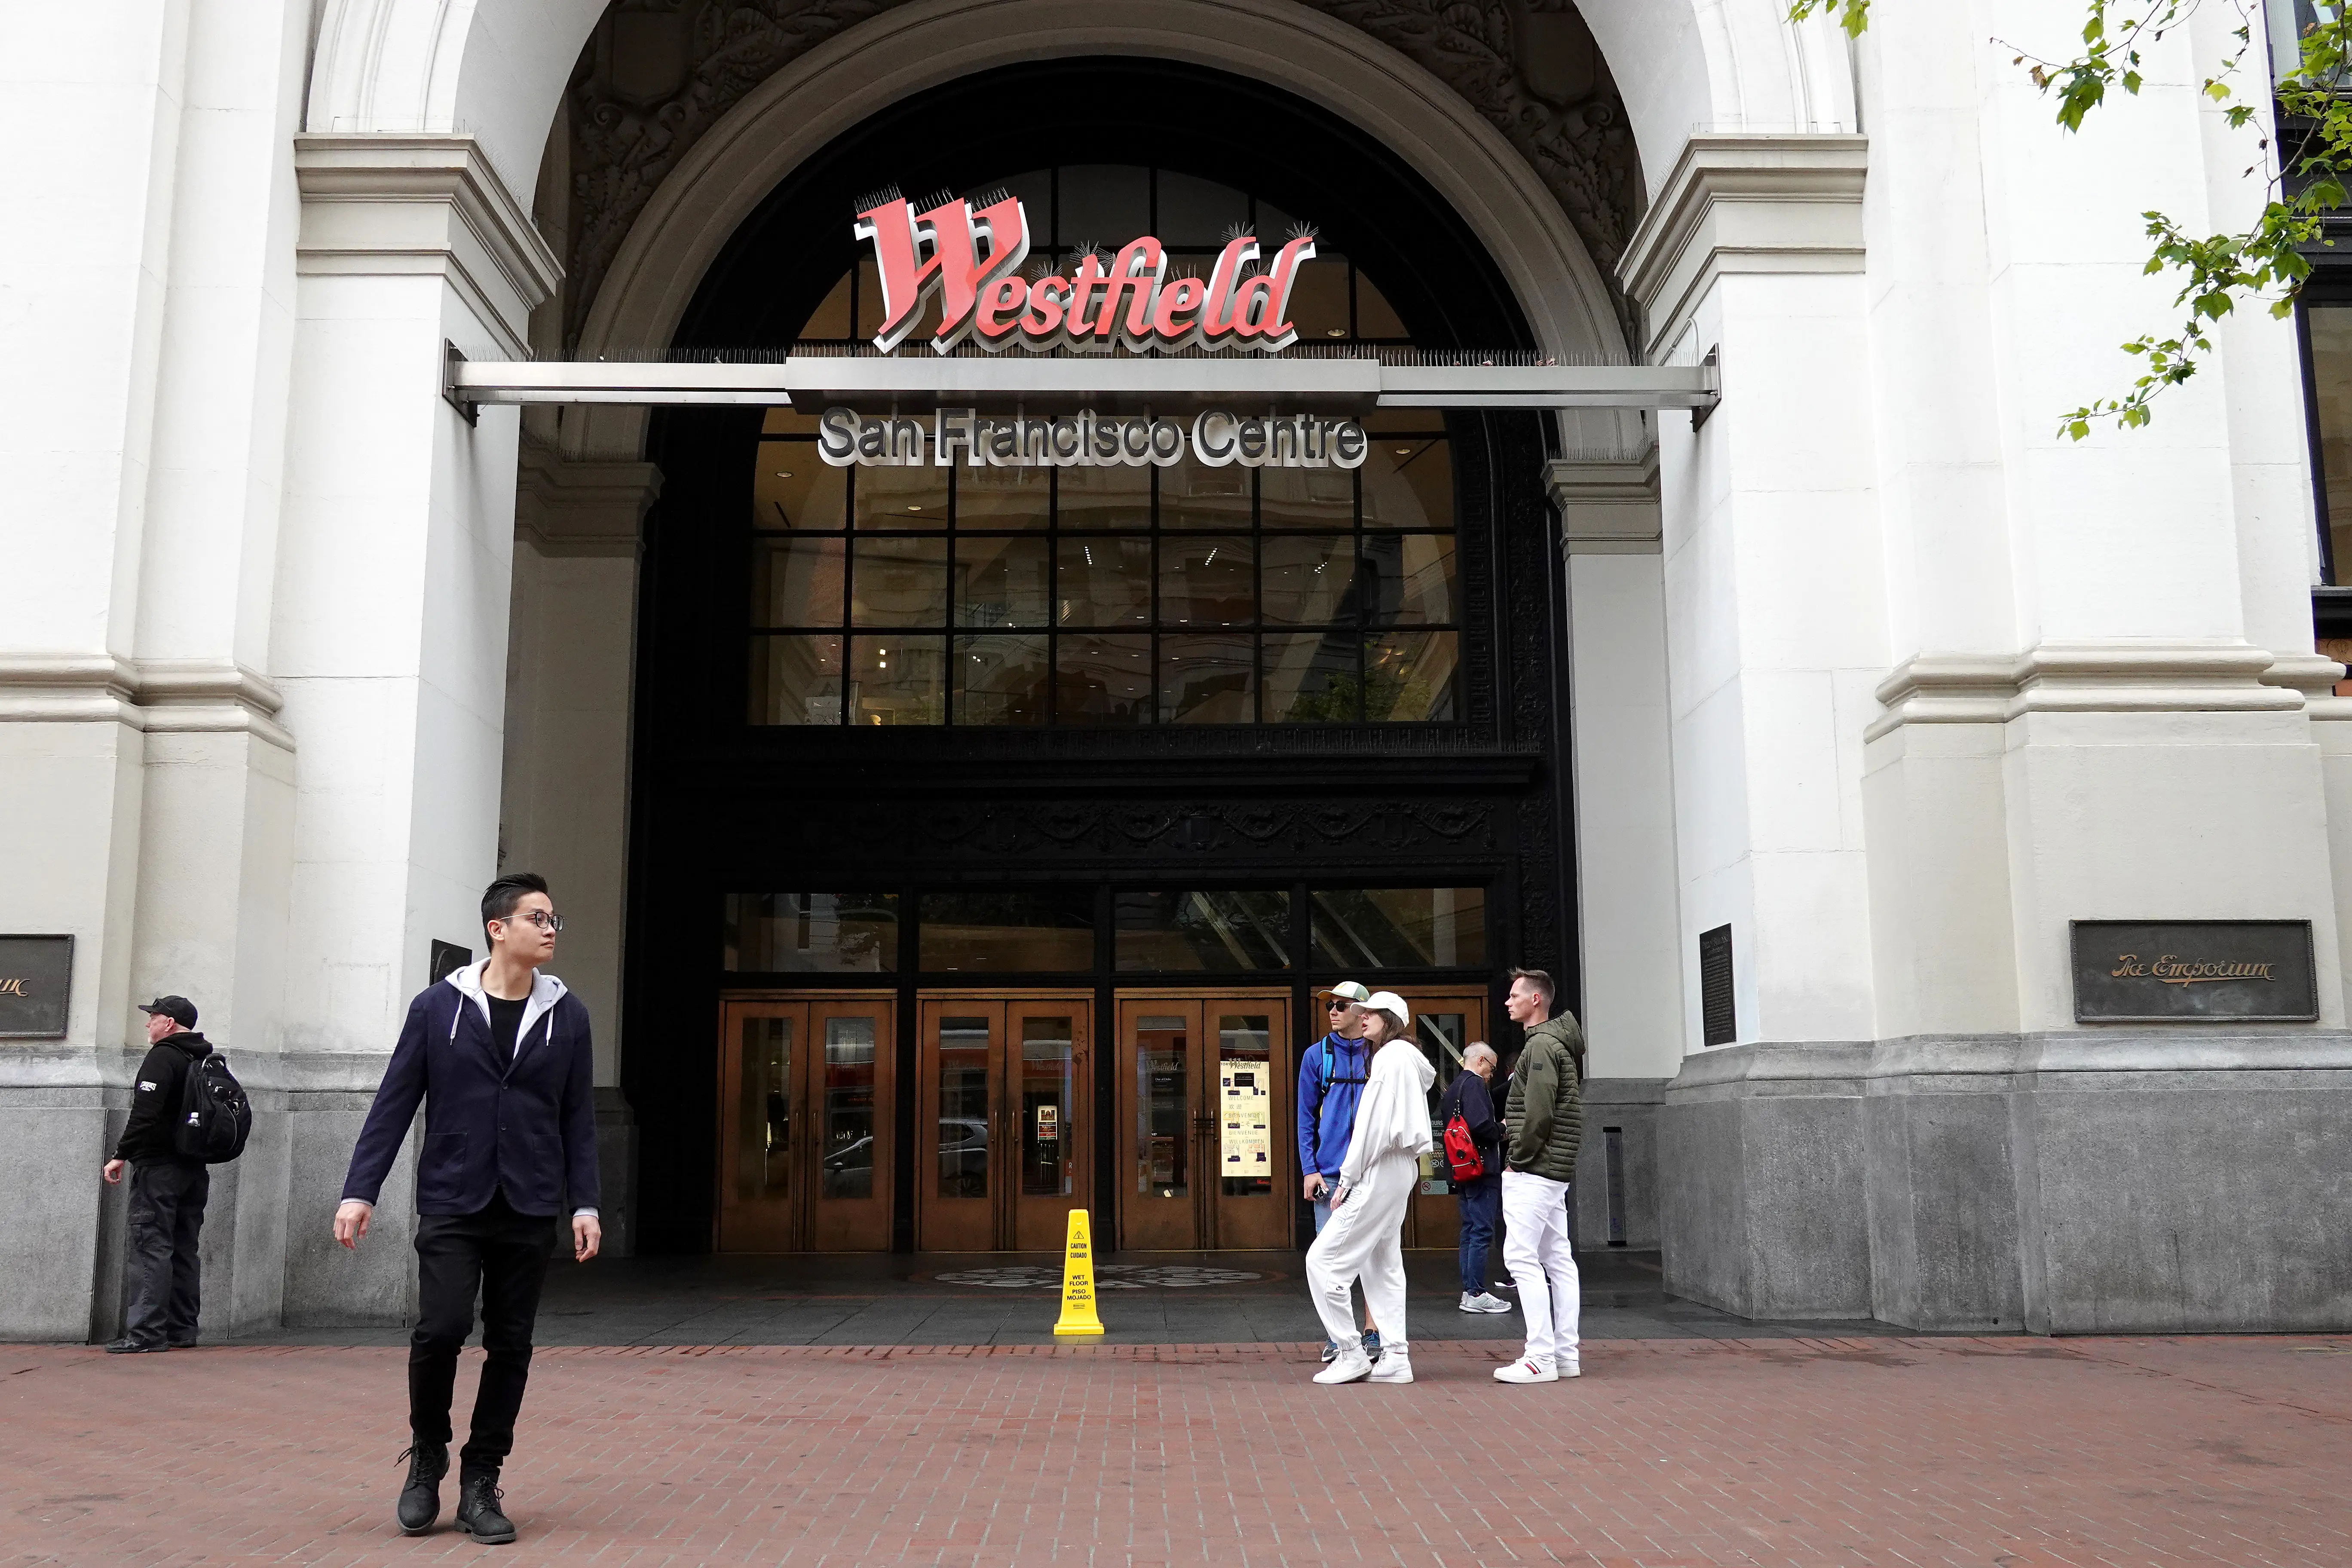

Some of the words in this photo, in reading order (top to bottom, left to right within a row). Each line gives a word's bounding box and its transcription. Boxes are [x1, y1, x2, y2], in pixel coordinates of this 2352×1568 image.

[854, 196, 1315, 352] Westfield
[818, 406, 924, 466] San
[935, 406, 1185, 467] Francisco
[1193, 406, 1367, 469] Centre
[2111, 954, 2151, 977] The
[2152, 954, 2275, 988] Emporium
[1228, 1057, 1262, 1069] Westfield
